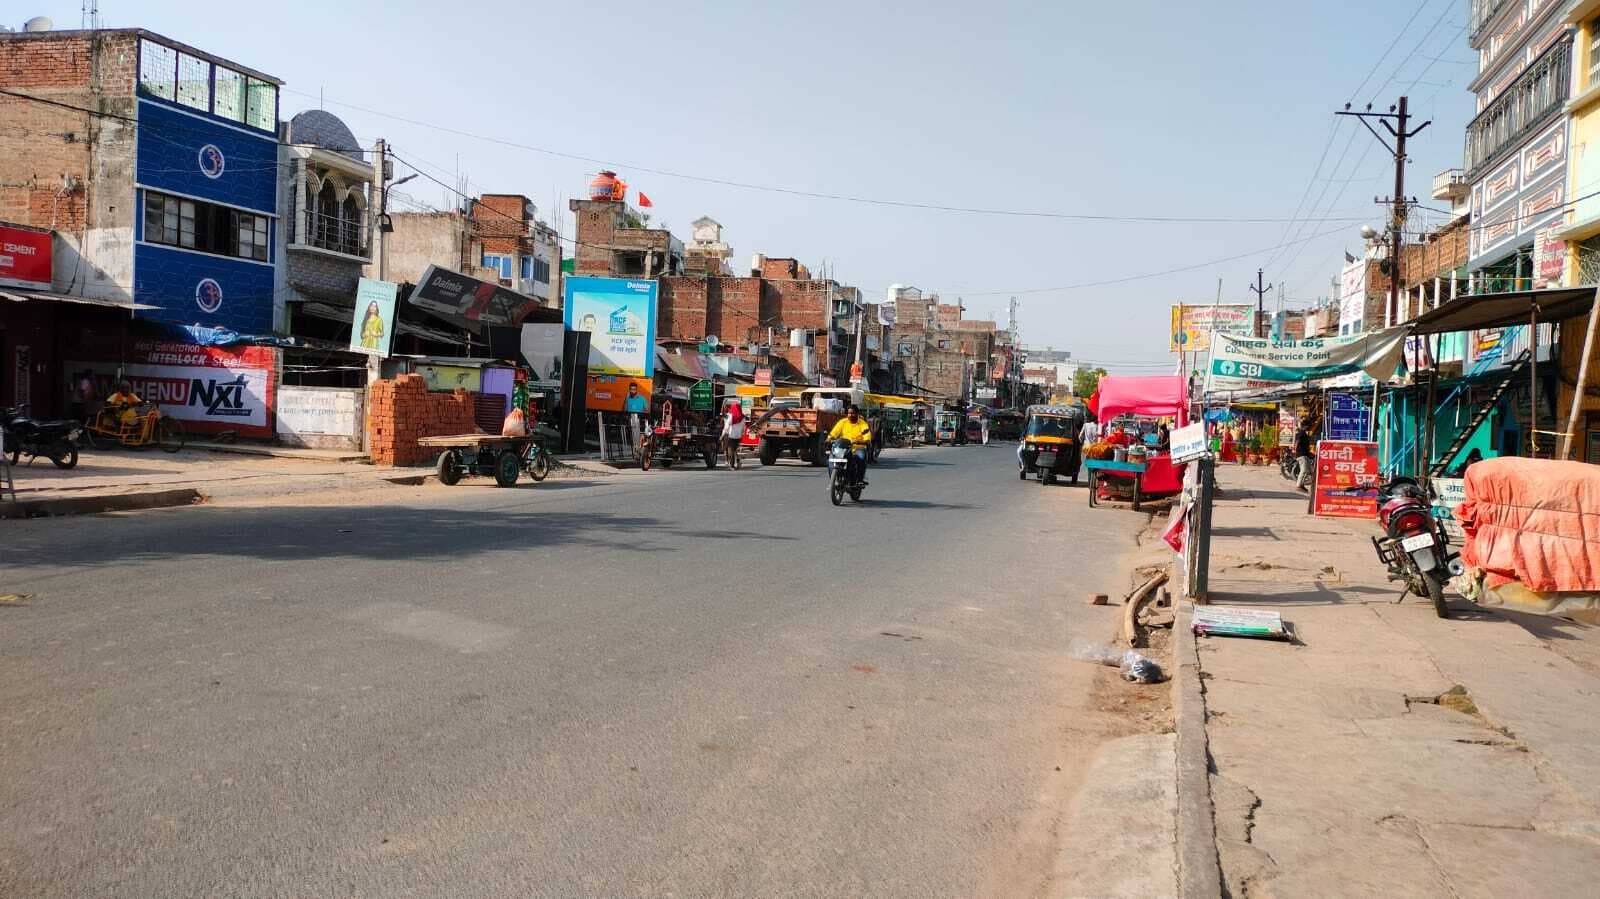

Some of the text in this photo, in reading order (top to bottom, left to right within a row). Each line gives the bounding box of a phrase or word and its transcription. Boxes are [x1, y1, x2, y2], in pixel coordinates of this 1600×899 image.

[432, 277, 463, 292] Dalmia
[627, 281, 651, 289] Dalmia
[148, 352, 242, 367] INTERLOCK Steel
[1268, 351, 1304, 361] Service
[1307, 351, 1330, 360] Point
[1239, 363, 1262, 377] SBI
[189, 373, 250, 416] Nxt
[1320, 447, 1354, 460] शादी
[1335, 459, 1368, 473] कार्ड
